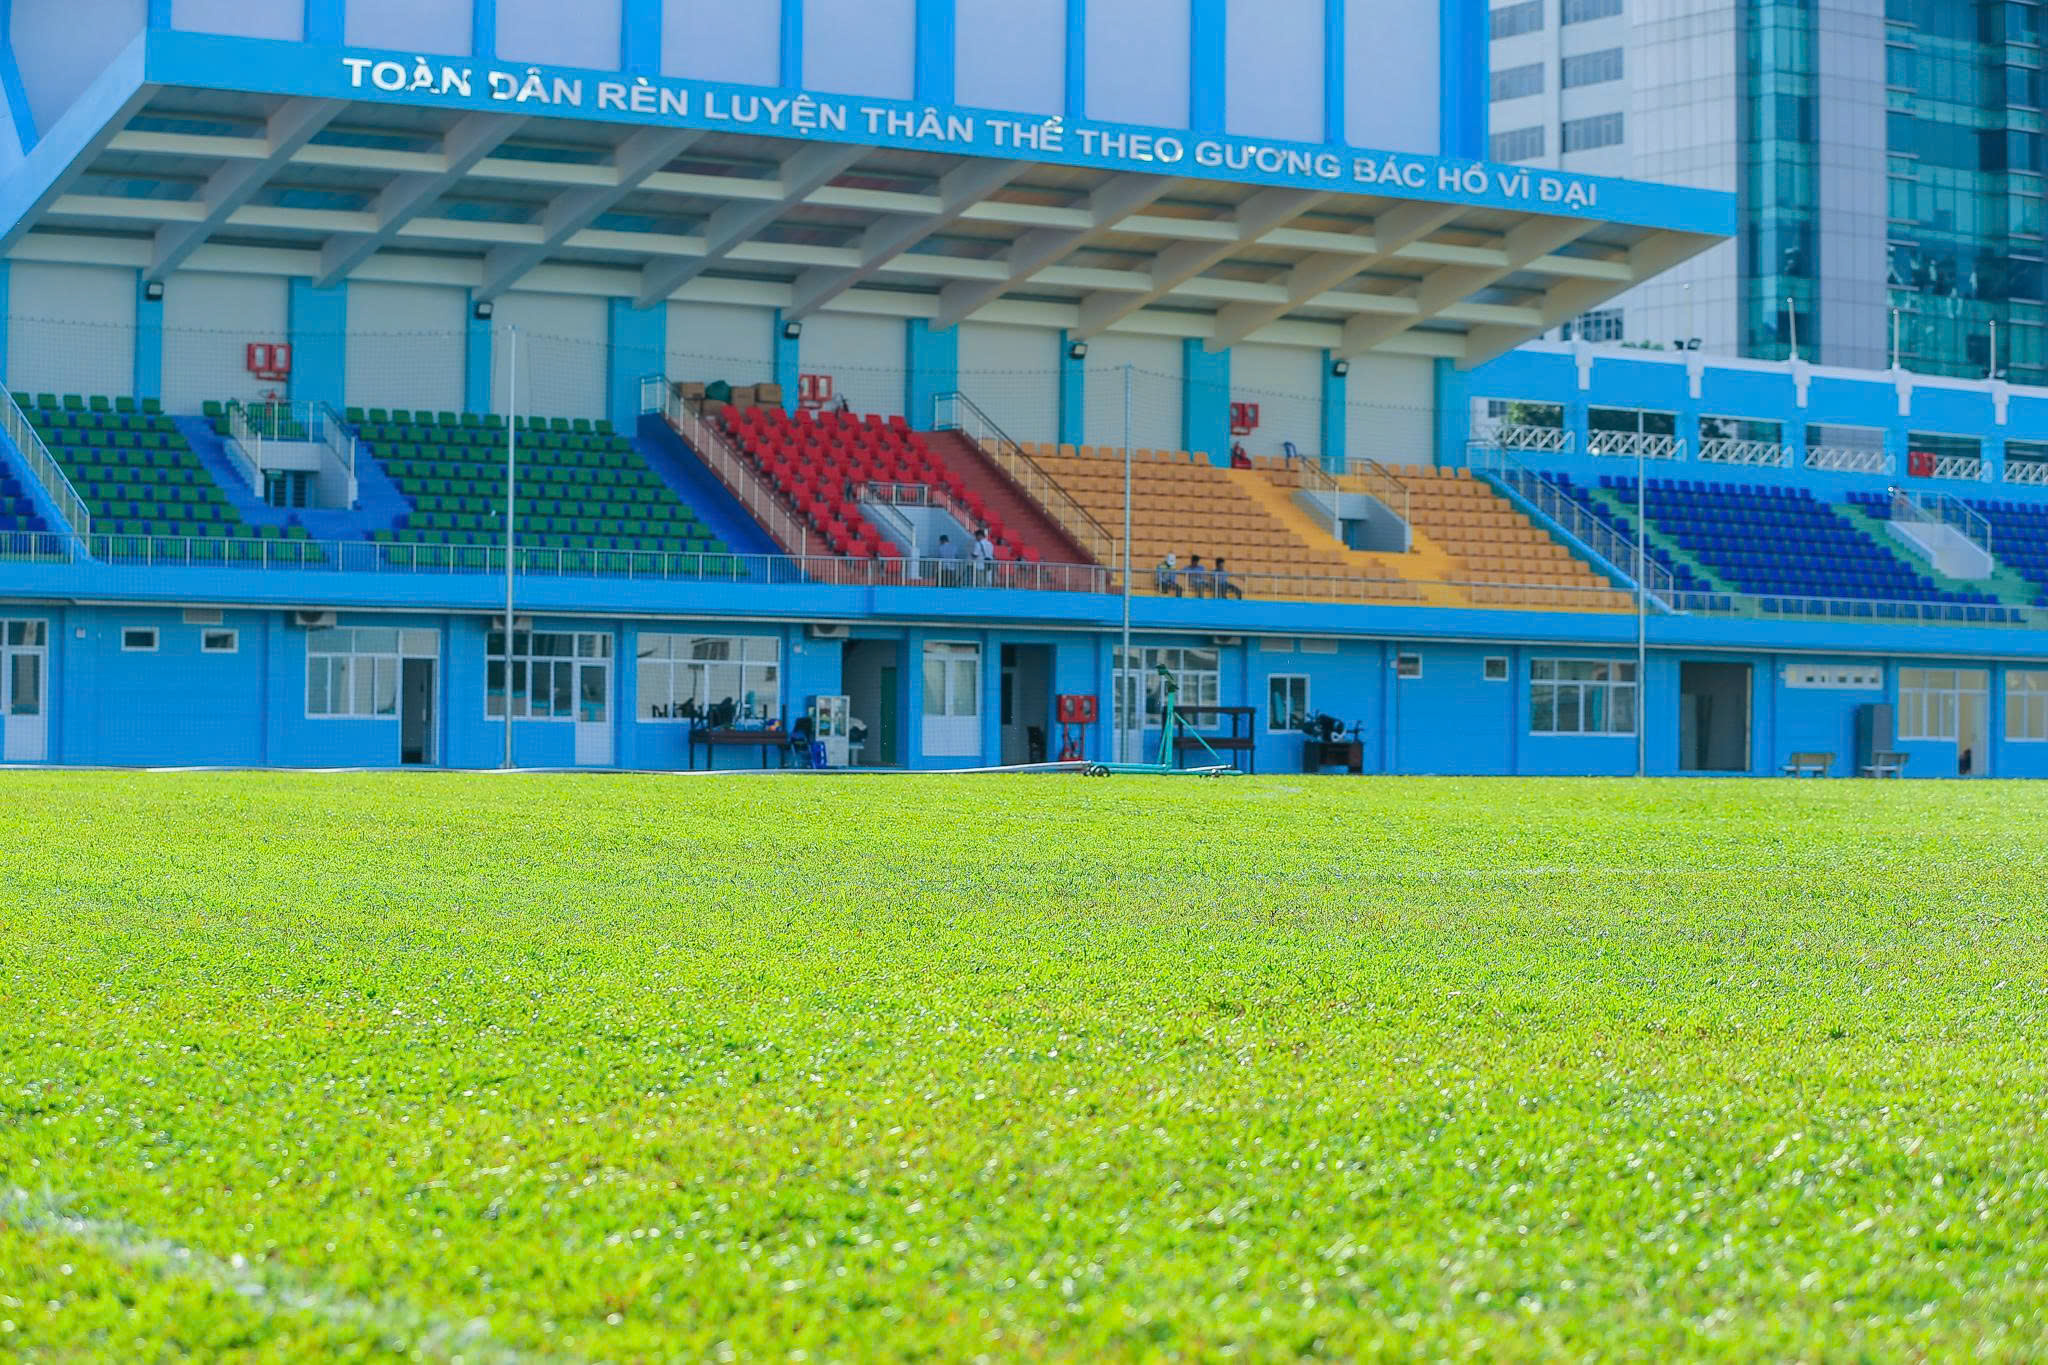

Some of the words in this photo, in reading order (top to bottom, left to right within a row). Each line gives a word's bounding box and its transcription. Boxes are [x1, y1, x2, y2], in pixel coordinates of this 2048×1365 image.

[342, 56, 472, 97] TOÀN
[487, 67, 582, 106] DÂN
[598, 77, 689, 116] RÈN
[704, 91, 846, 134] LUYỆN
[860, 106, 974, 143] THÂN
[985, 115, 1064, 152] THỂ
[1075, 128, 1184, 163] THEO
[1194, 140, 1342, 179] GƯƠNG
[1352, 155, 1426, 188] BÁC
[1539, 178, 1597, 210] ĐẠI
